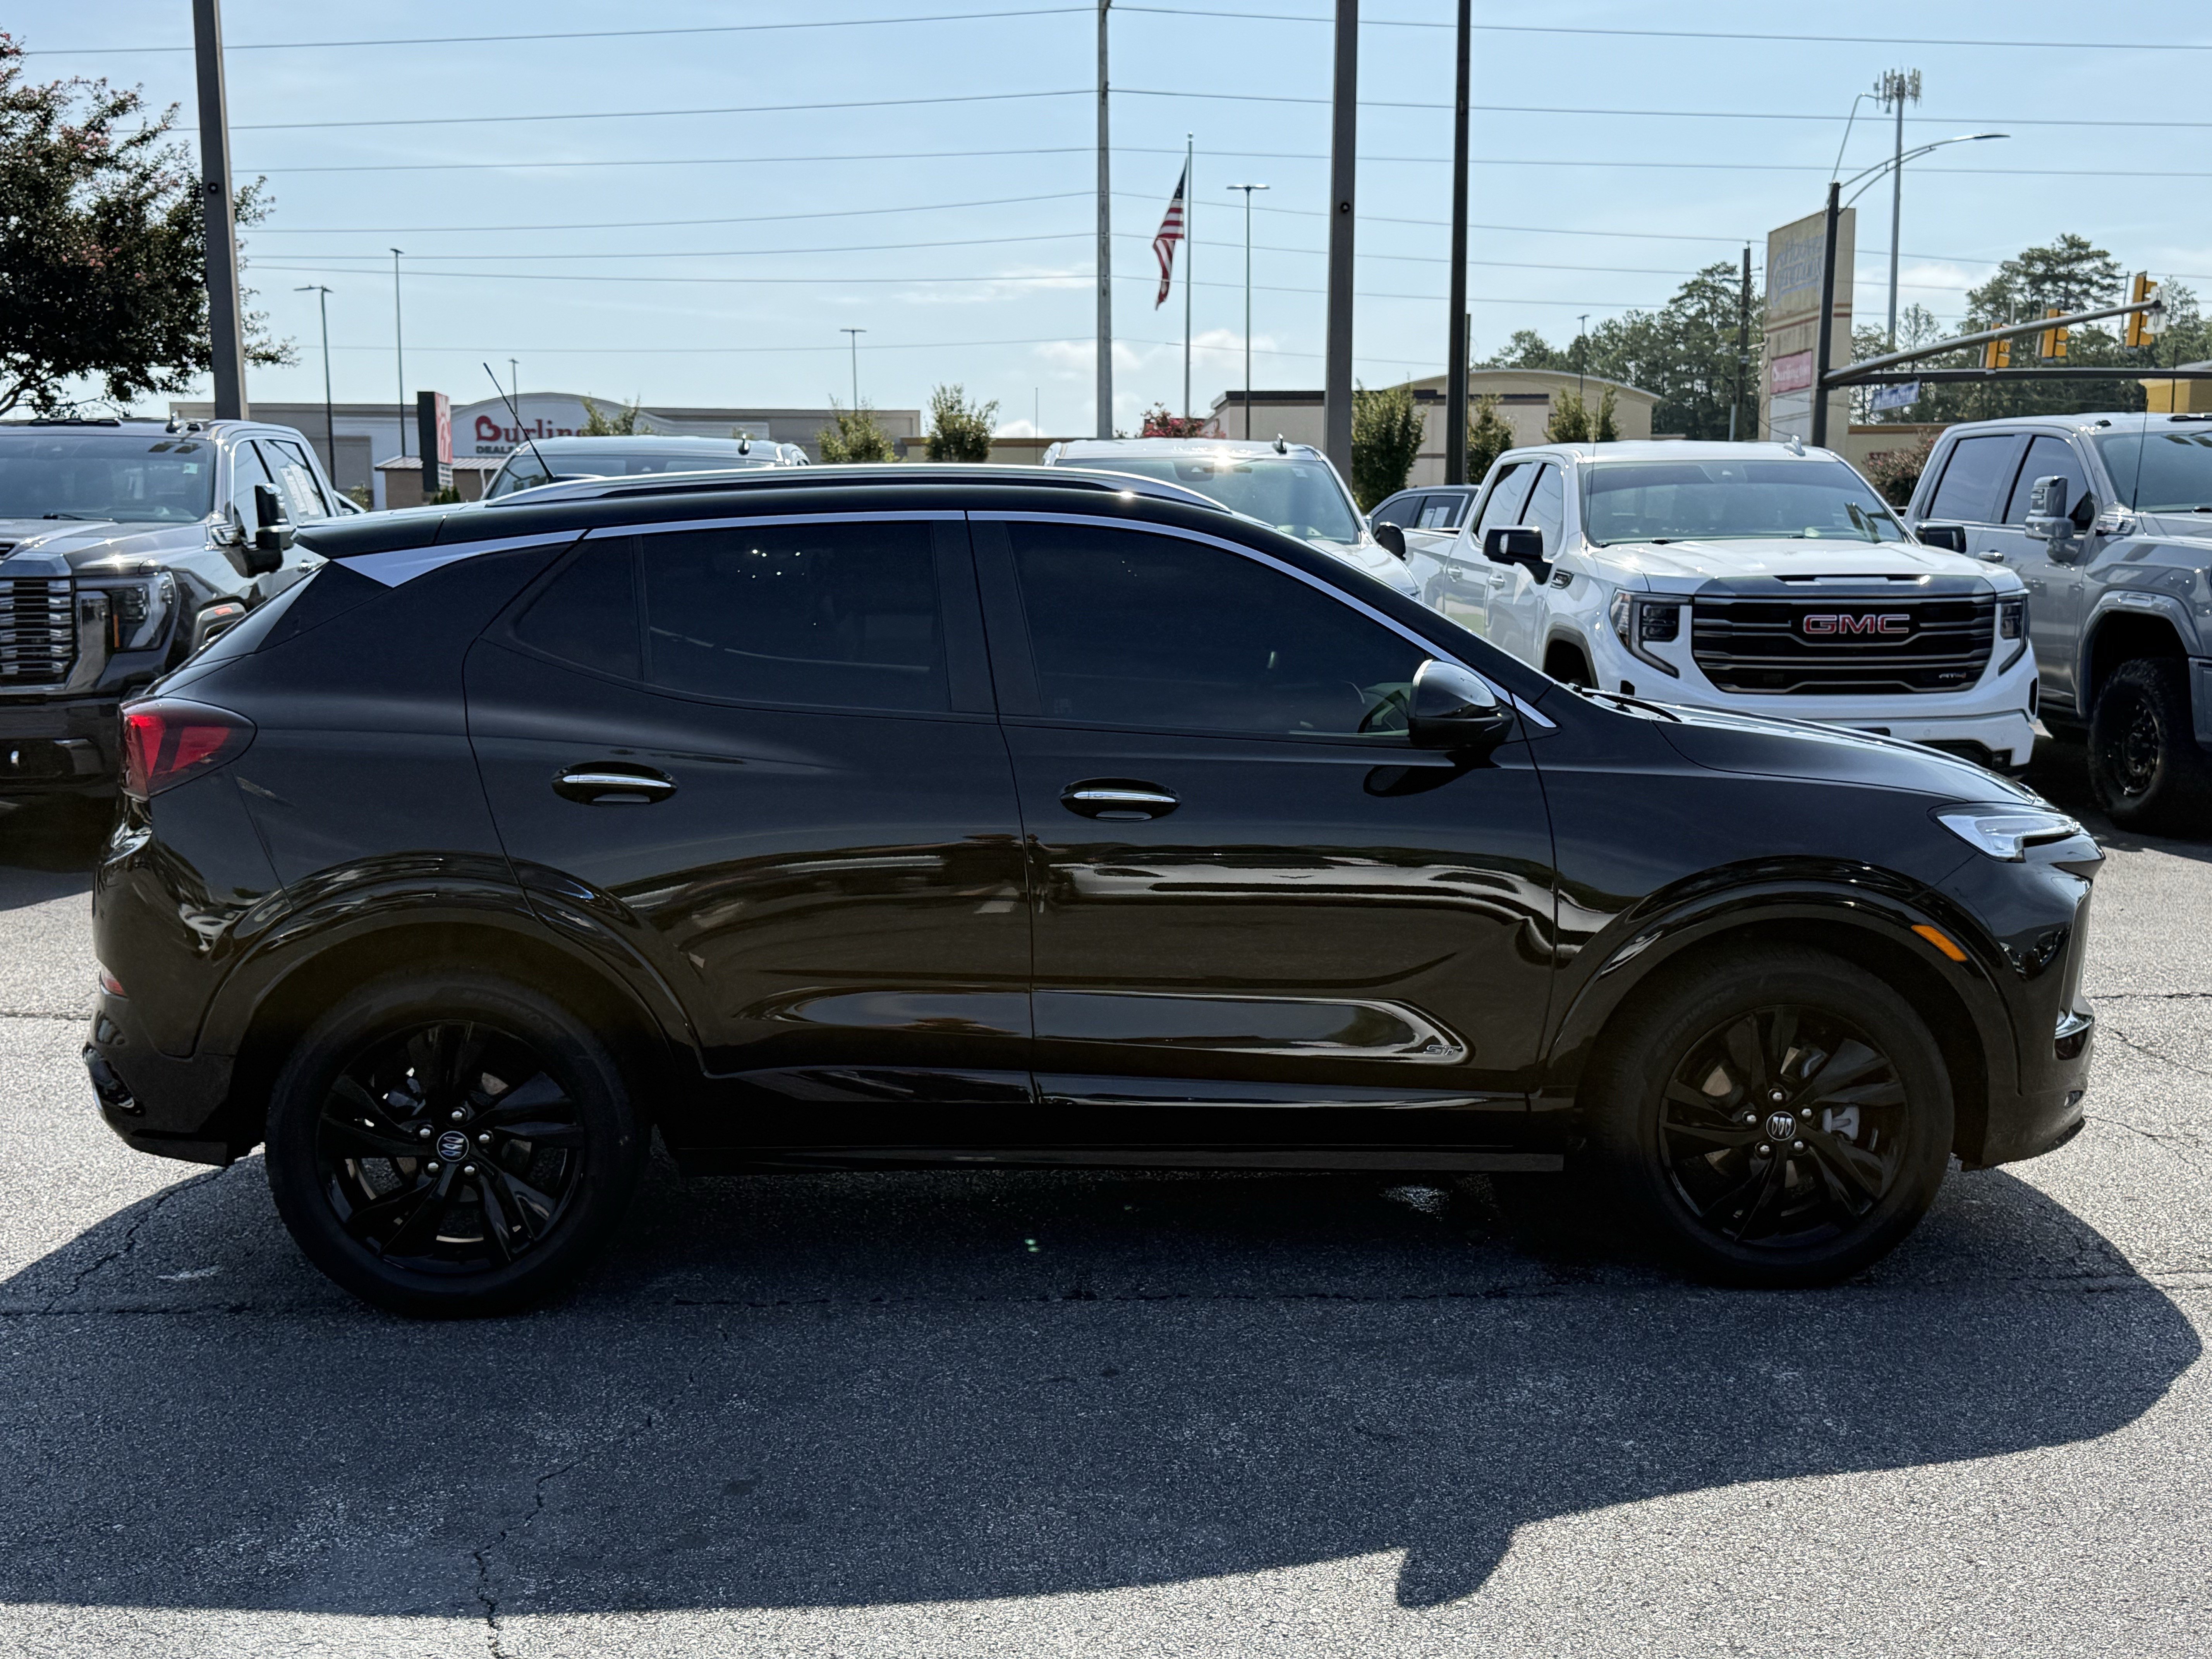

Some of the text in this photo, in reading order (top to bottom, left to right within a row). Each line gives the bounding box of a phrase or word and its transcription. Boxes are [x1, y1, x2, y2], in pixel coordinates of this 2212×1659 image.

[475, 416, 582, 442] Burlin
[1803, 614, 1910, 634] GMC
[1423, 1044, 1461, 1055] ST
